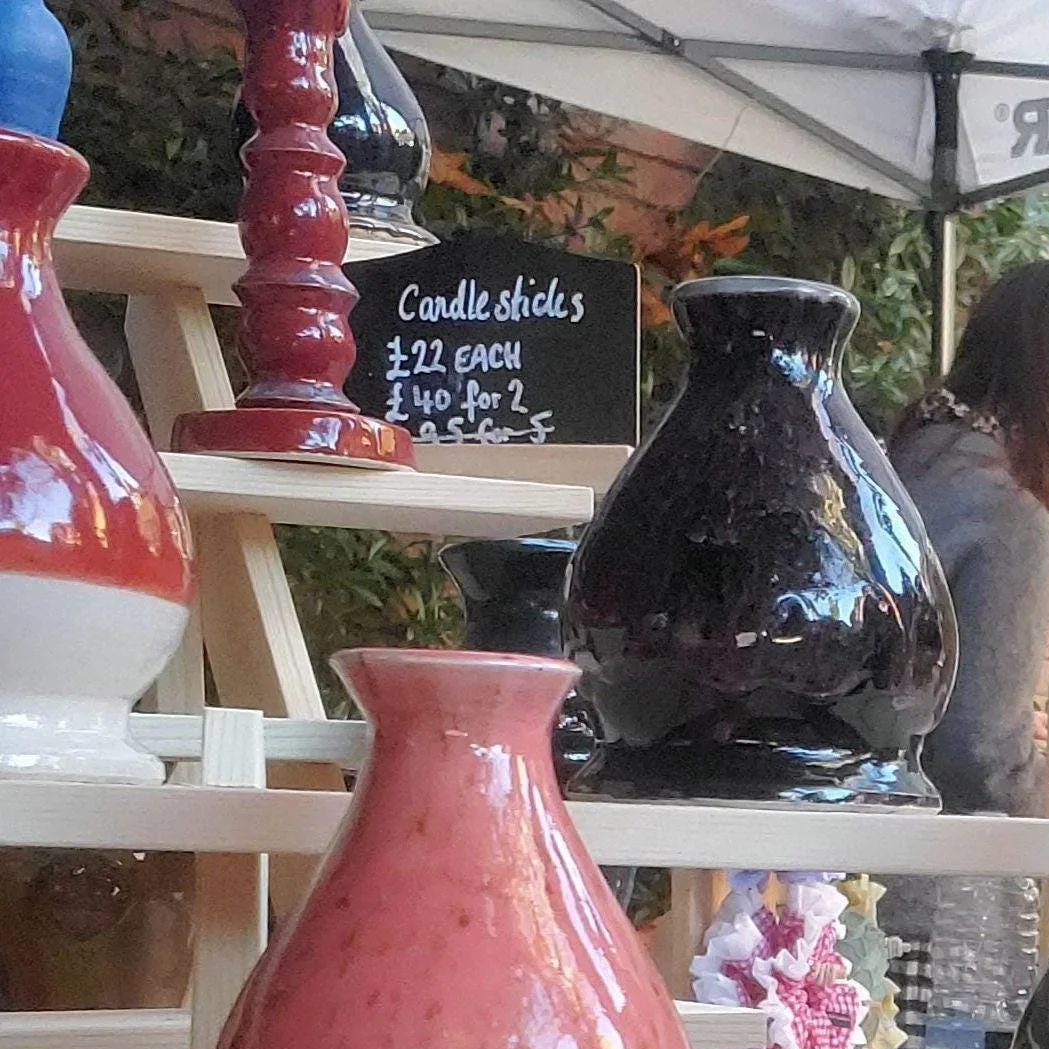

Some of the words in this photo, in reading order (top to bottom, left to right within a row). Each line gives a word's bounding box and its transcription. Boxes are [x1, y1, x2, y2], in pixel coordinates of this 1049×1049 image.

[386, 335, 447, 380] £22
[454, 340, 522, 373] EACH
[460, 379, 502, 423] for
[507, 378, 529, 414] 2
